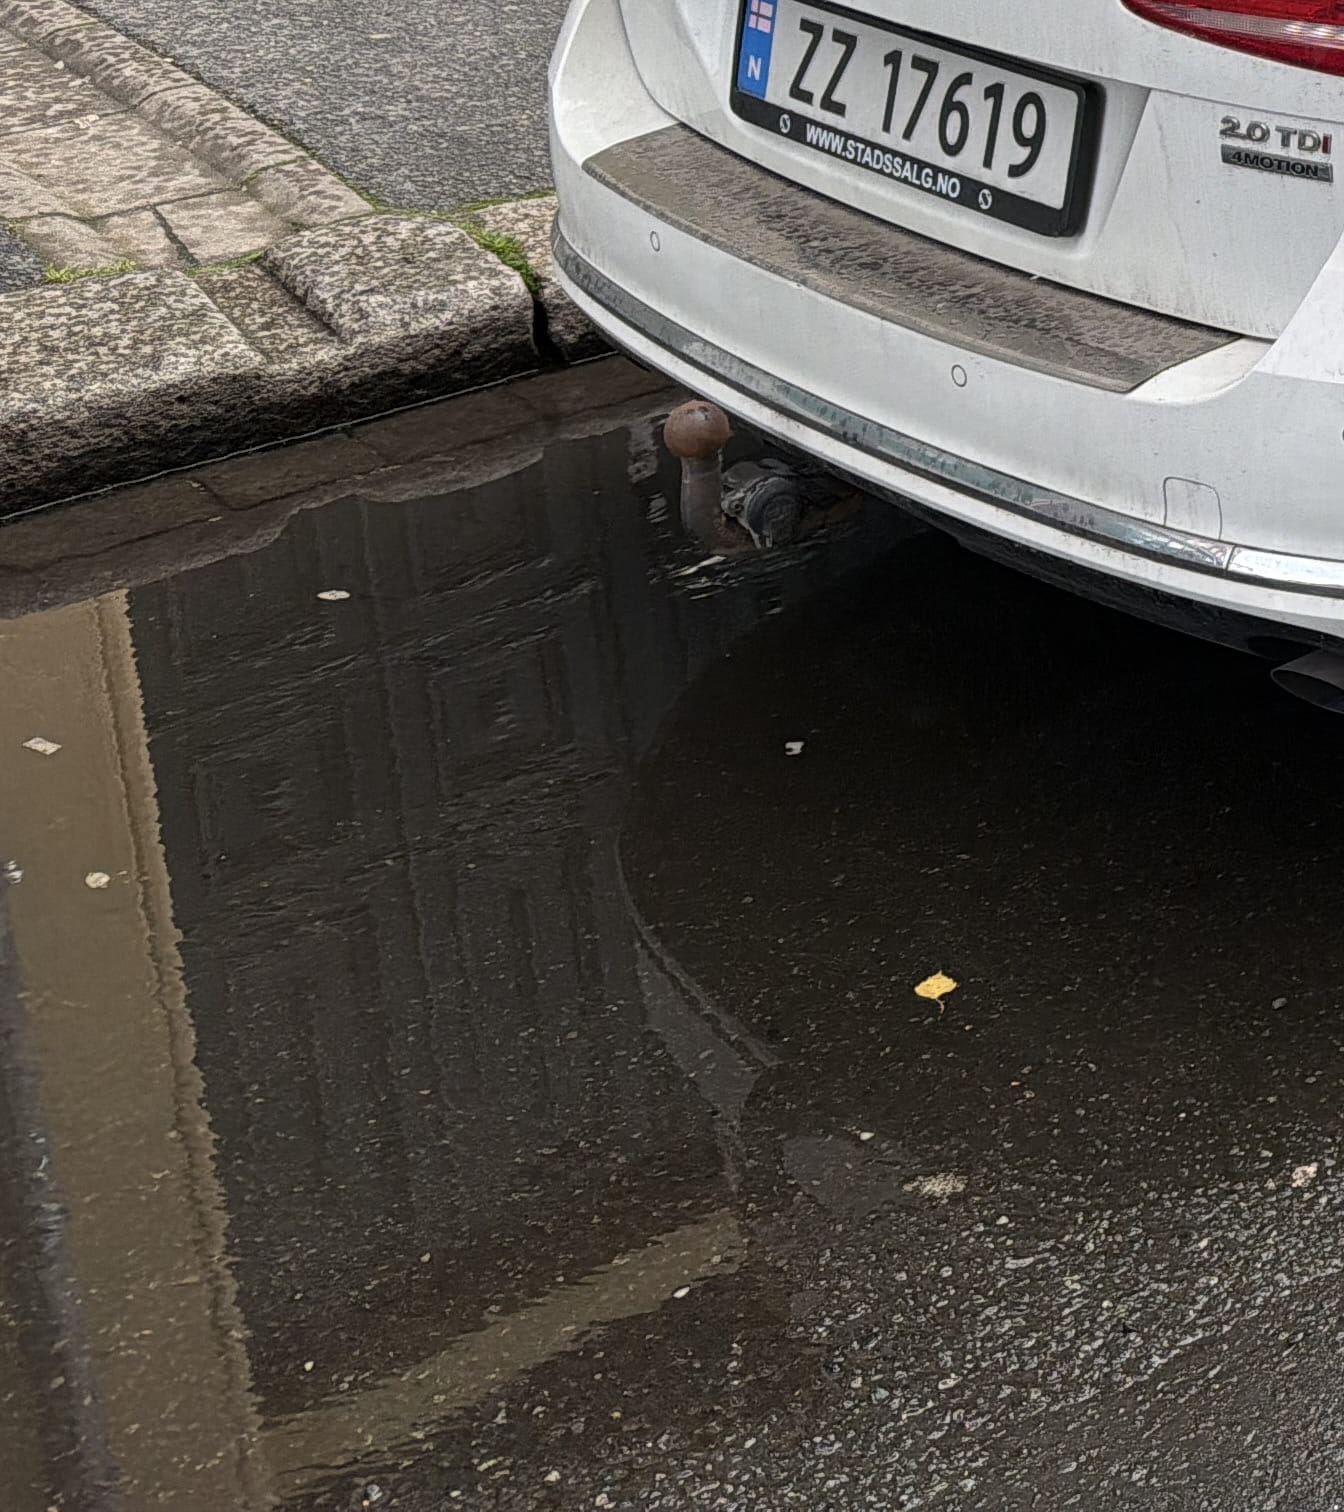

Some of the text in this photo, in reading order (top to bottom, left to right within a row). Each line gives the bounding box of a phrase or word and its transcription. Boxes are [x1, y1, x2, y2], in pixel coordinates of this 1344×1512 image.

[746, 53, 762, 81] N
[788, 17, 1047, 179] ZZ 17619
[1274, 124, 1333, 155] TDI
[805, 122, 961, 199] WWW.STADSSALG.NO
[1230, 150, 1319, 178] 4MOTION
